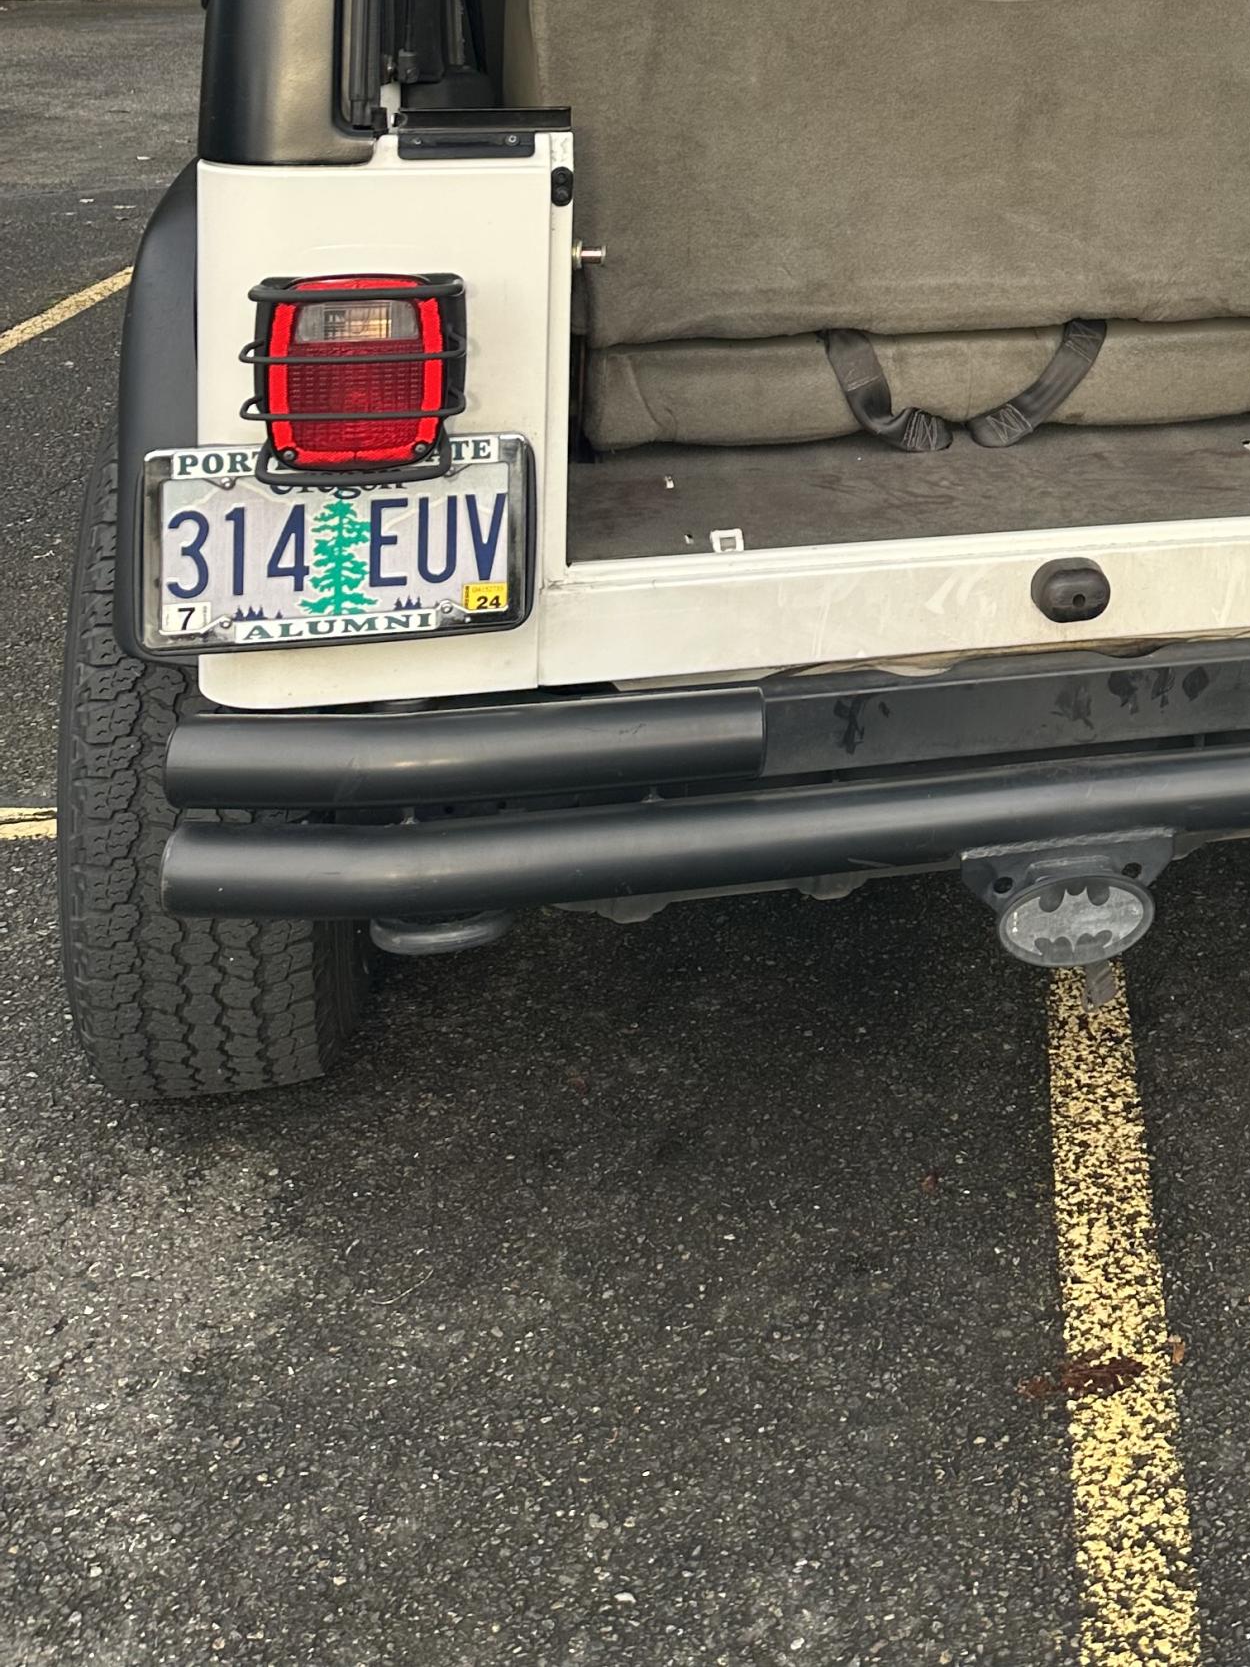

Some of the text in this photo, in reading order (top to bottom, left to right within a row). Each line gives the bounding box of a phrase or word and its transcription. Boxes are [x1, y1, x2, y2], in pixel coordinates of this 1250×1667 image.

[167, 491, 508, 599] 314 EUV
[476, 594, 502, 610] 24
[177, 606, 196, 631] 7
[243, 612, 433, 641] ALUMNI
